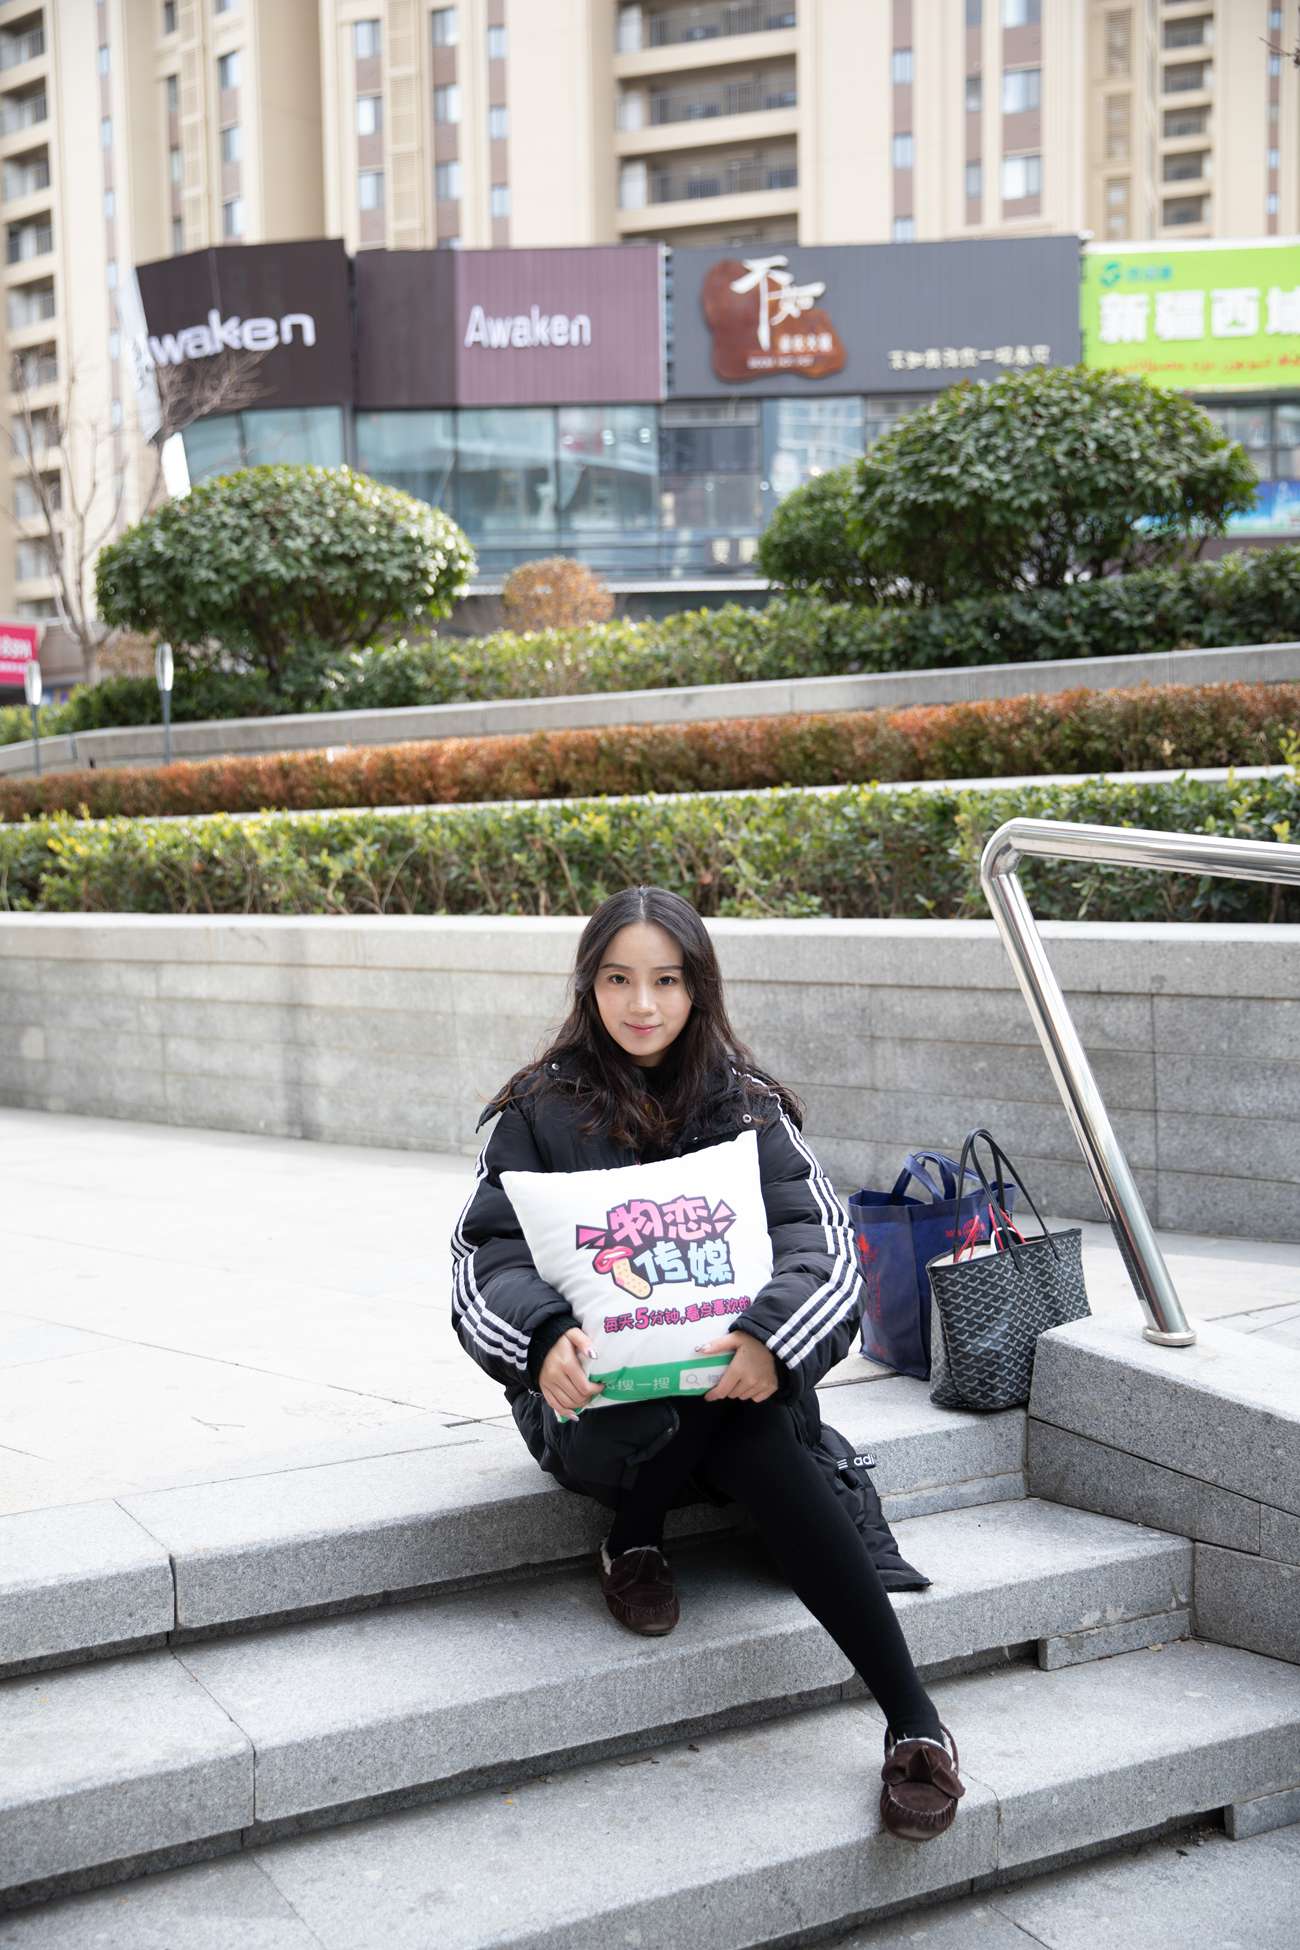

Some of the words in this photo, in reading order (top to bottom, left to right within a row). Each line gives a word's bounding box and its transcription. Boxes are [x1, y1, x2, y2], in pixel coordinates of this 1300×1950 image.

[463, 304, 592, 350] Awaken
[608, 1197, 712, 1247] 物恋
[634, 1239, 734, 1286] 传媒
